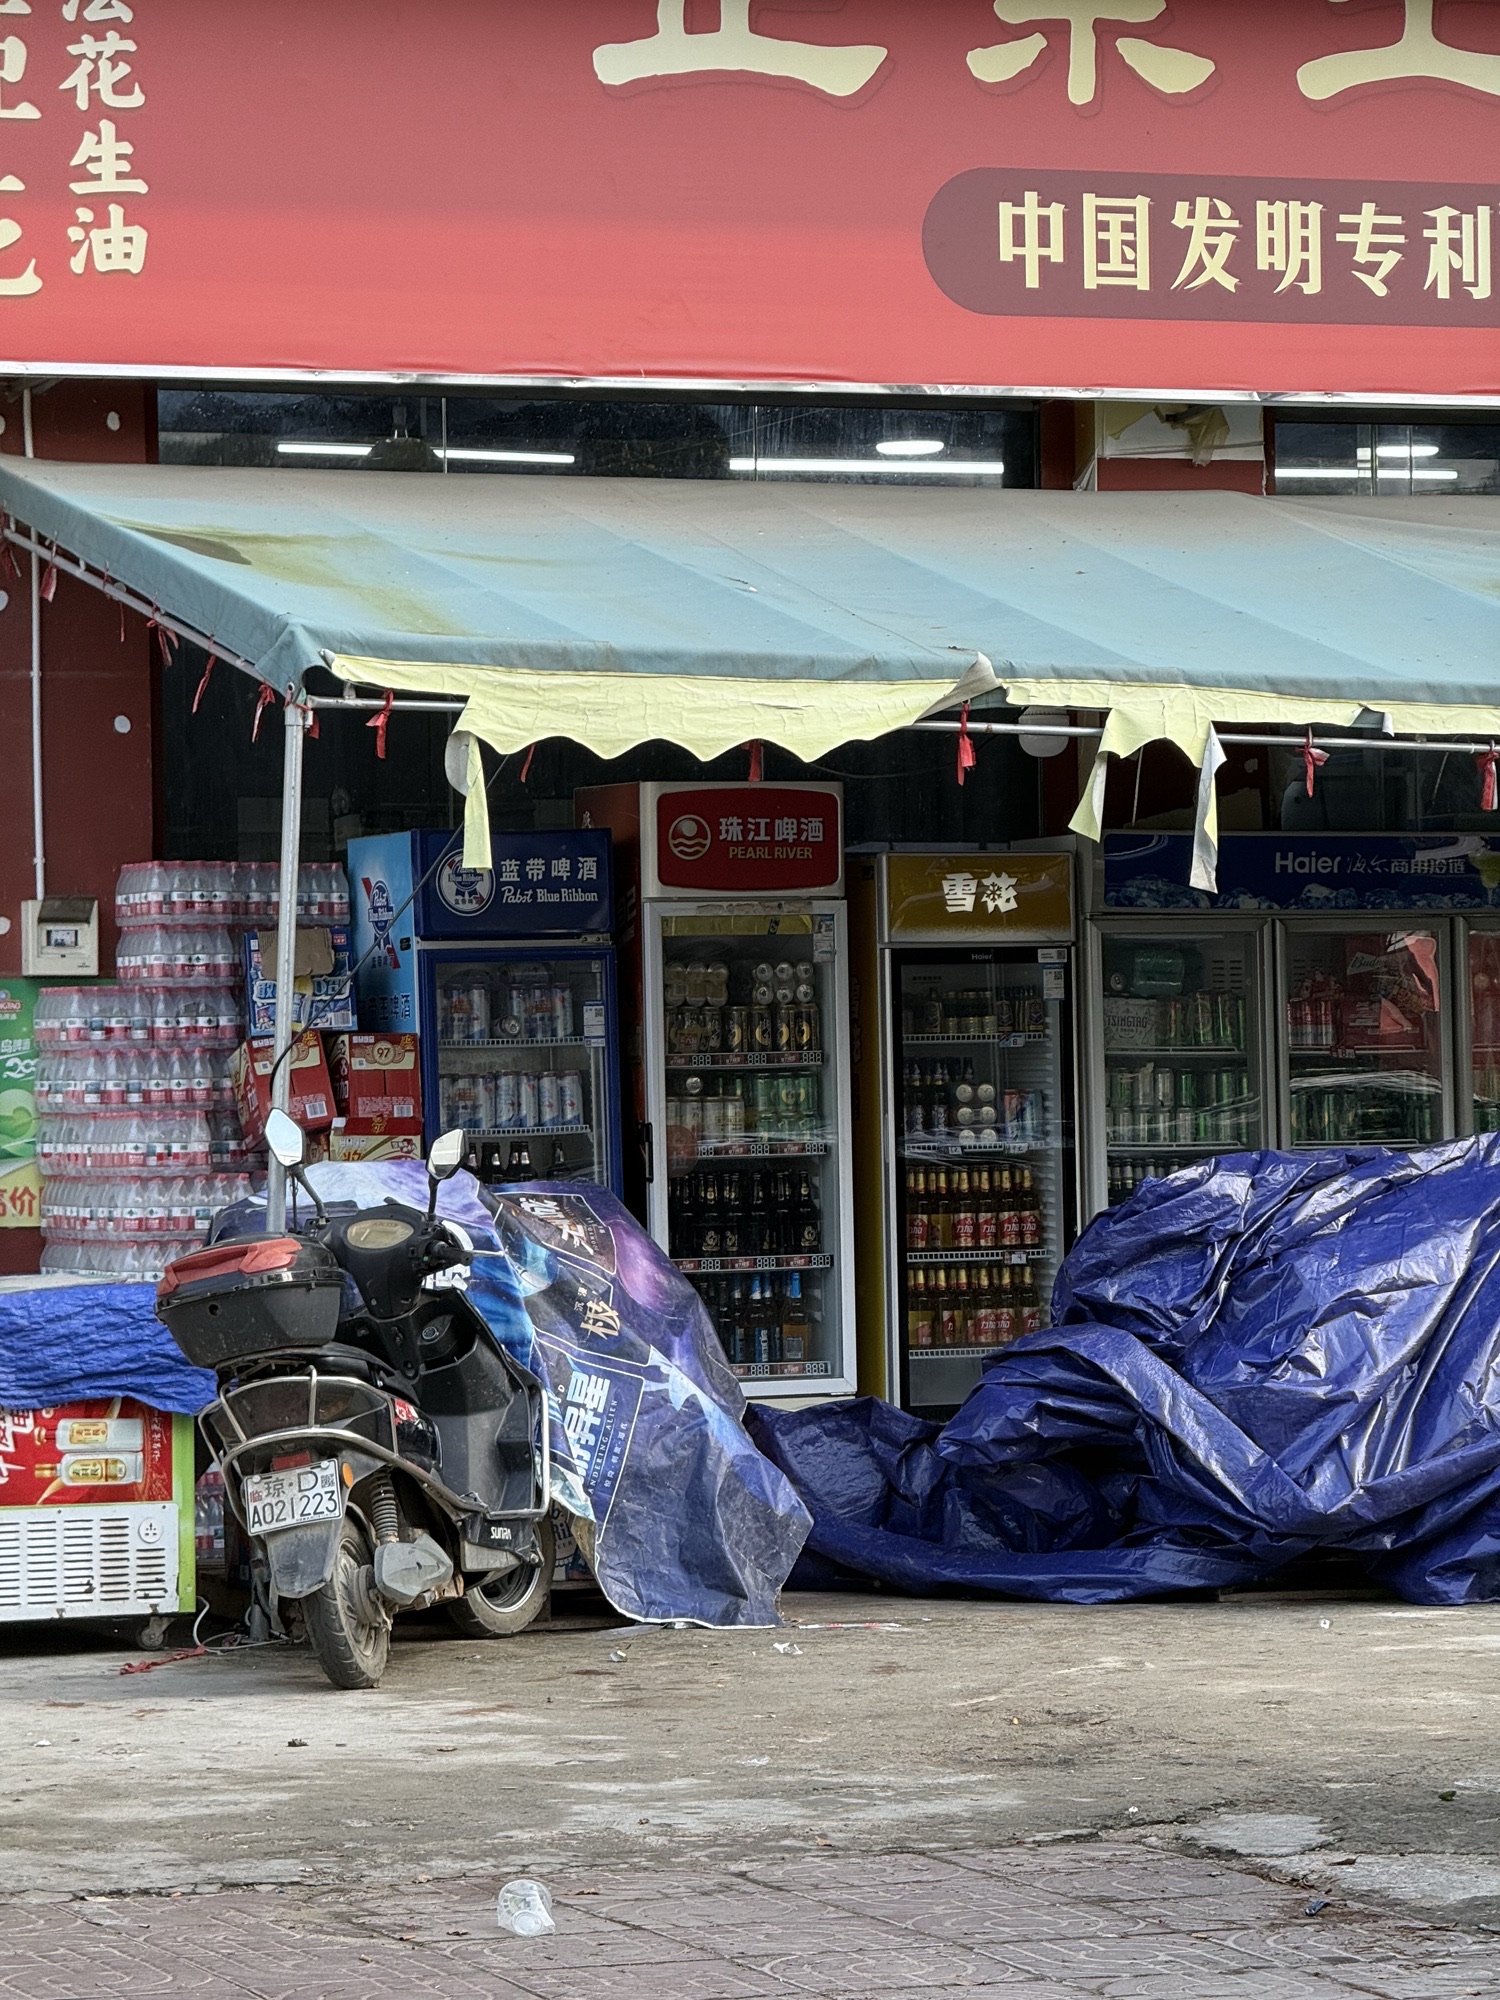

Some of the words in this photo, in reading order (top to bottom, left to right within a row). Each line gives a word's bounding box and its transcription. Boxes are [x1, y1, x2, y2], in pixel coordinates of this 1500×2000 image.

[997, 190, 1493, 300] 中国发明专利
[719, 816, 824, 842] 珠江啤酒
[729, 846, 772, 859] PEARL
[774, 846, 813, 859] RIVER
[1274, 850, 1342, 874] Haier
[500, 857, 598, 882] 蓝带啤酒
[501, 885, 533, 904] Pabst
[536, 888, 560, 903] Blue
[561, 887, 599, 903] Ribbon
[941, 871, 1018, 914] 雪花
[377, 1047, 391, 1058] 97
[250, 1490, 263, 1504] 临
[251, 1489, 338, 1529] A021223
